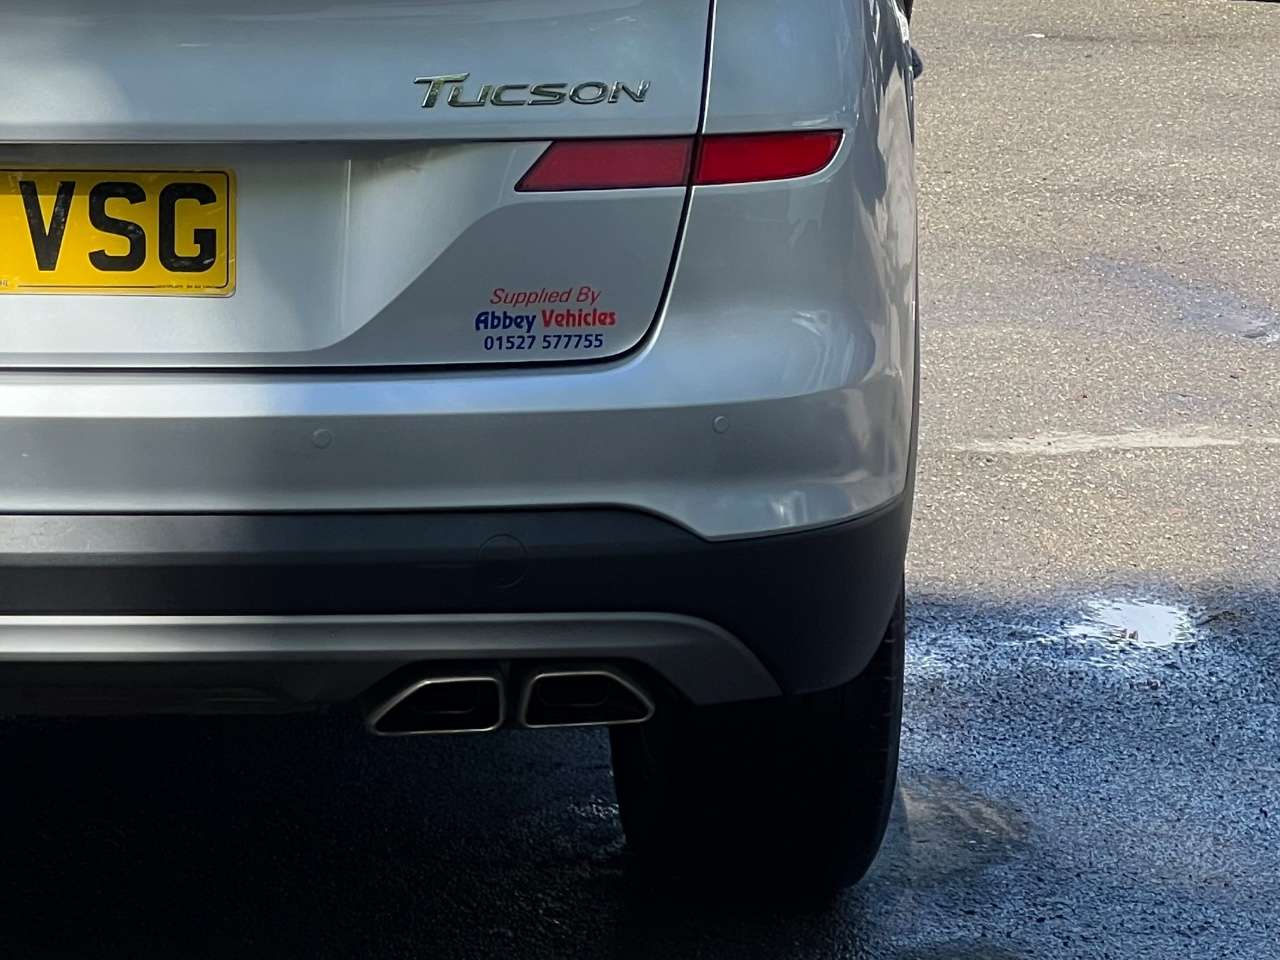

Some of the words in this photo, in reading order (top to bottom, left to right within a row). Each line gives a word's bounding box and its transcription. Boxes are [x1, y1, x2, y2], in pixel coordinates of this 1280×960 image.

[18, 179, 218, 273] VSG
[489, 287, 572, 307] Supplied
[576, 286, 602, 306] By
[475, 311, 536, 333] Abbey
[541, 308, 616, 328] Vehicles
[483, 336, 536, 350] 01527
[542, 334, 603, 349] 577755
